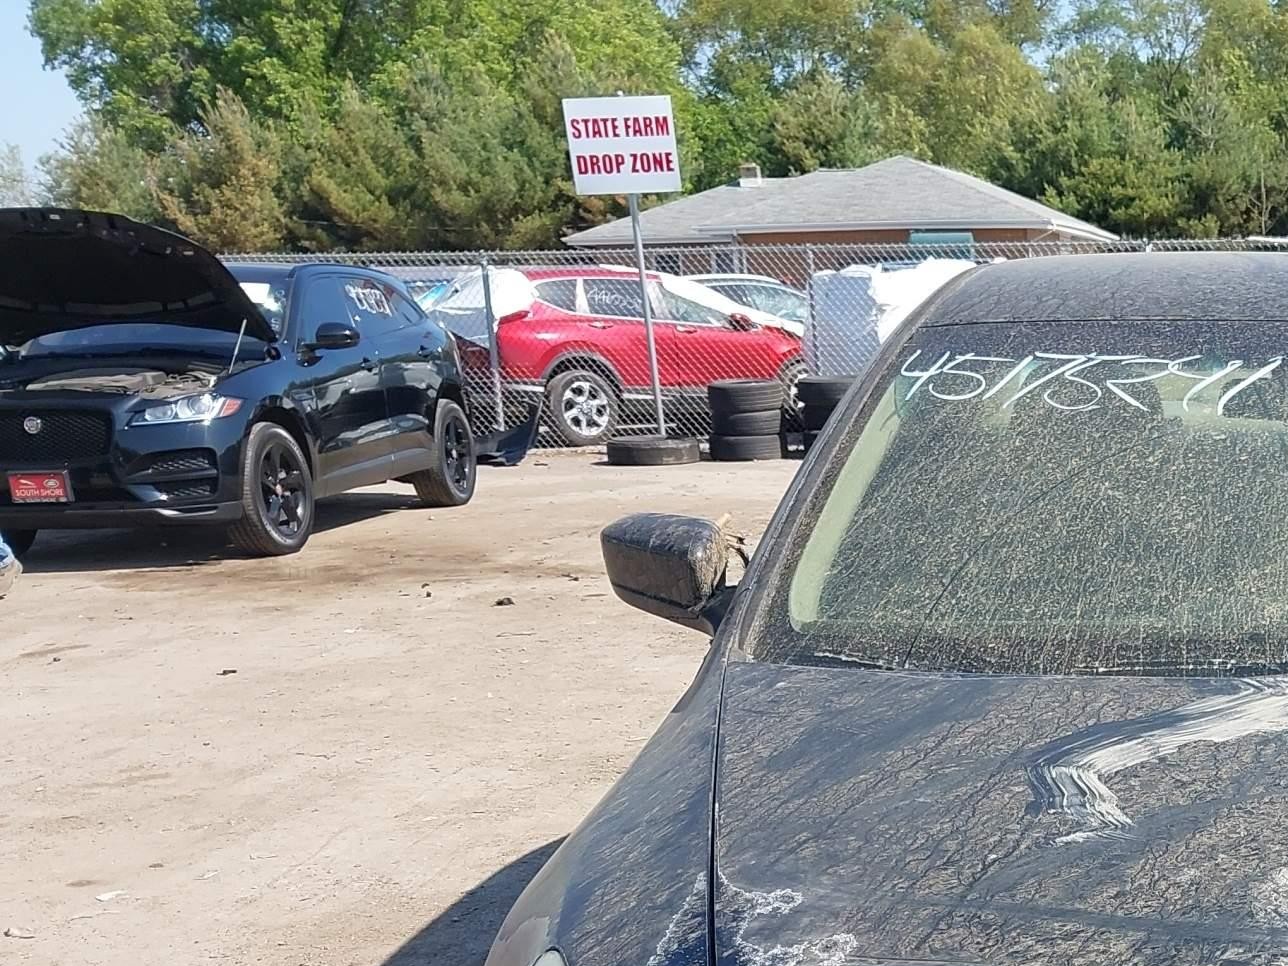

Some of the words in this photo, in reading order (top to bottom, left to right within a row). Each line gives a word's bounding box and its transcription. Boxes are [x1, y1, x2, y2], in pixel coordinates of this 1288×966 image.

[570, 117, 621, 139] STATE
[623, 115, 670, 138] FARM
[576, 153, 626, 175] DROP
[629, 152, 675, 173] ZONE
[15, 489, 40, 497] SOUTH
[40, 488, 65, 497] SHORE
